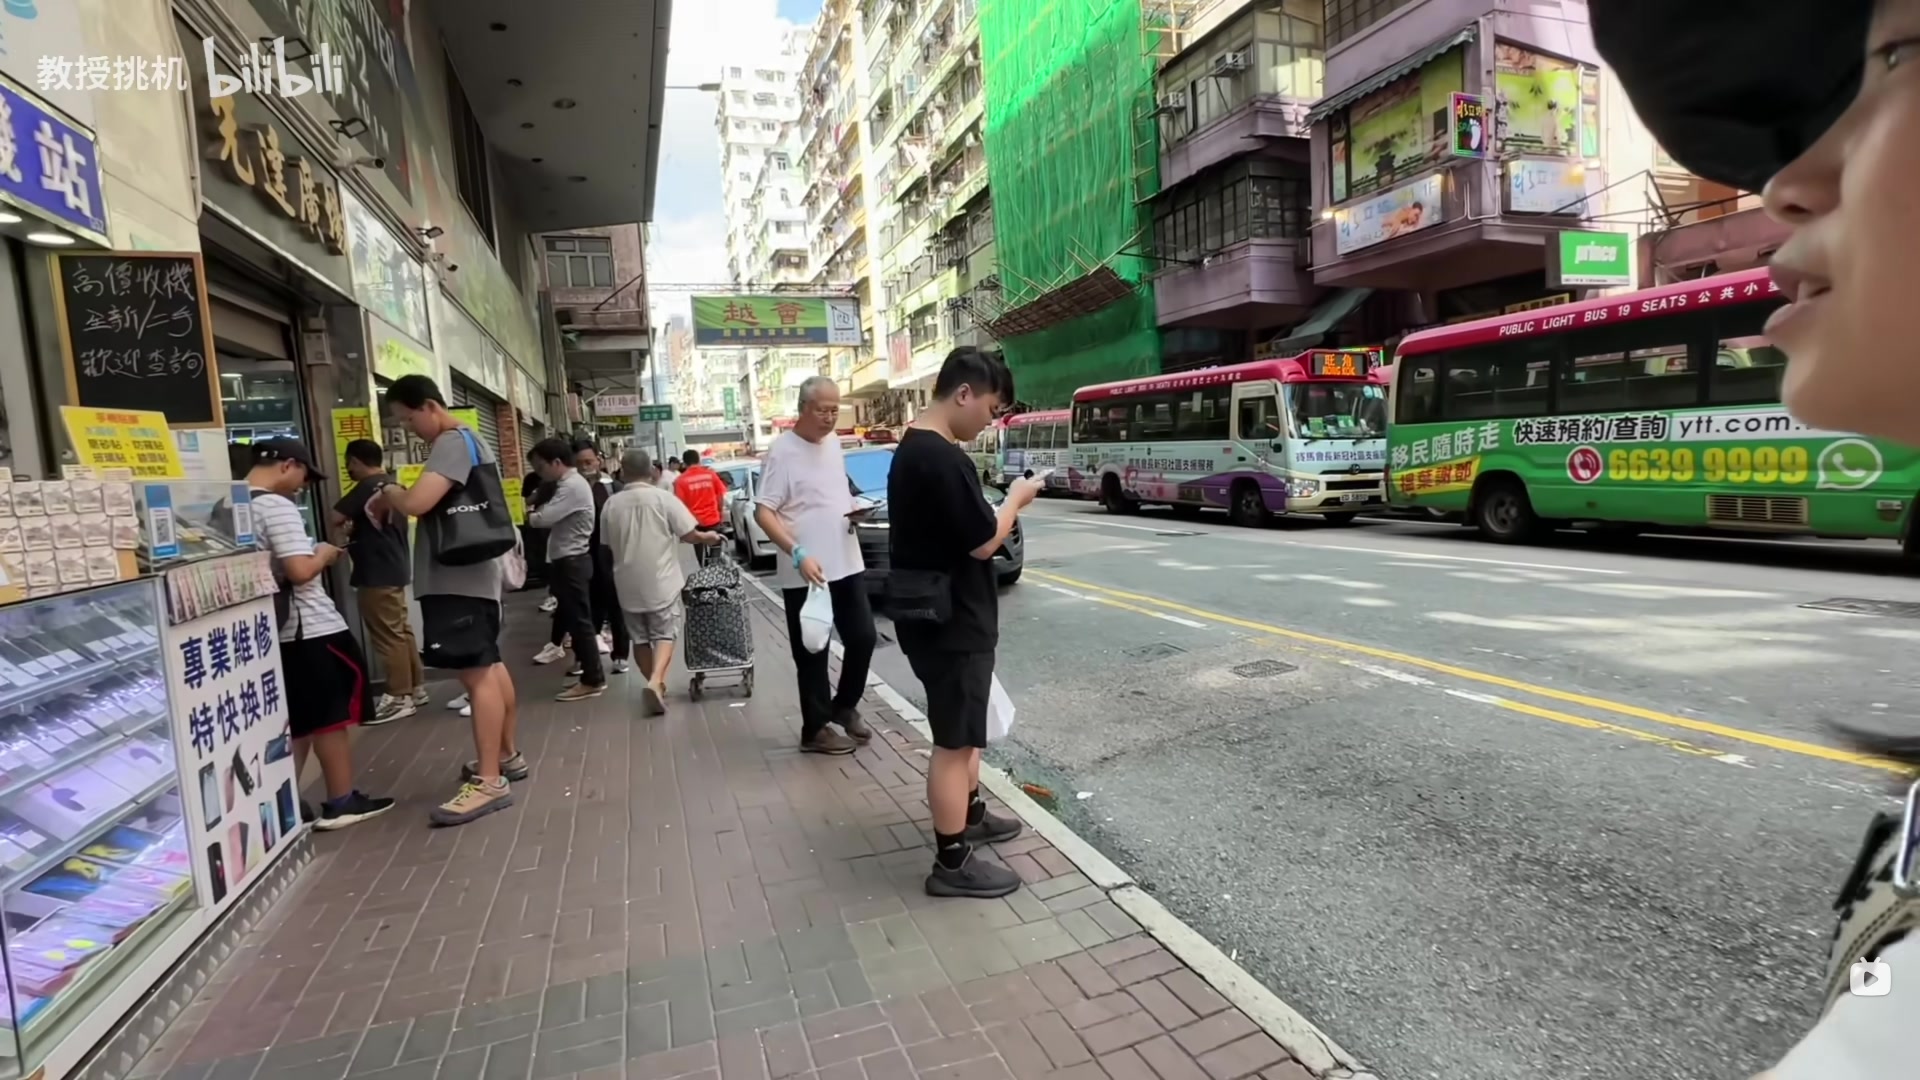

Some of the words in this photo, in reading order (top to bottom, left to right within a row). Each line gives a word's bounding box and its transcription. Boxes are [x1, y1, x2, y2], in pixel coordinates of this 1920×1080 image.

[72, 261, 195, 301] 高價收機
[1499, 321, 1535, 337] PUBLIC
[1542, 314, 1576, 330] LIGHT
[1583, 308, 1608, 322] BUS
[1617, 304, 1631, 317] 19
[1641, 294, 1687, 313] SEATS
[80, 346, 204, 379] 歡迎查詢
[1324, 353, 1353, 367] 旺角
[1391, 421, 1501, 471] 移民隨時走
[1513, 414, 1667, 444] 快速預約/查詢
[1609, 448, 1695, 481] 6639
[1703, 446, 1809, 484] 9999
[446, 501, 489, 515] SONY
[180, 612, 273, 690] 專業維修
[189, 667, 281, 760] 特快換屏
